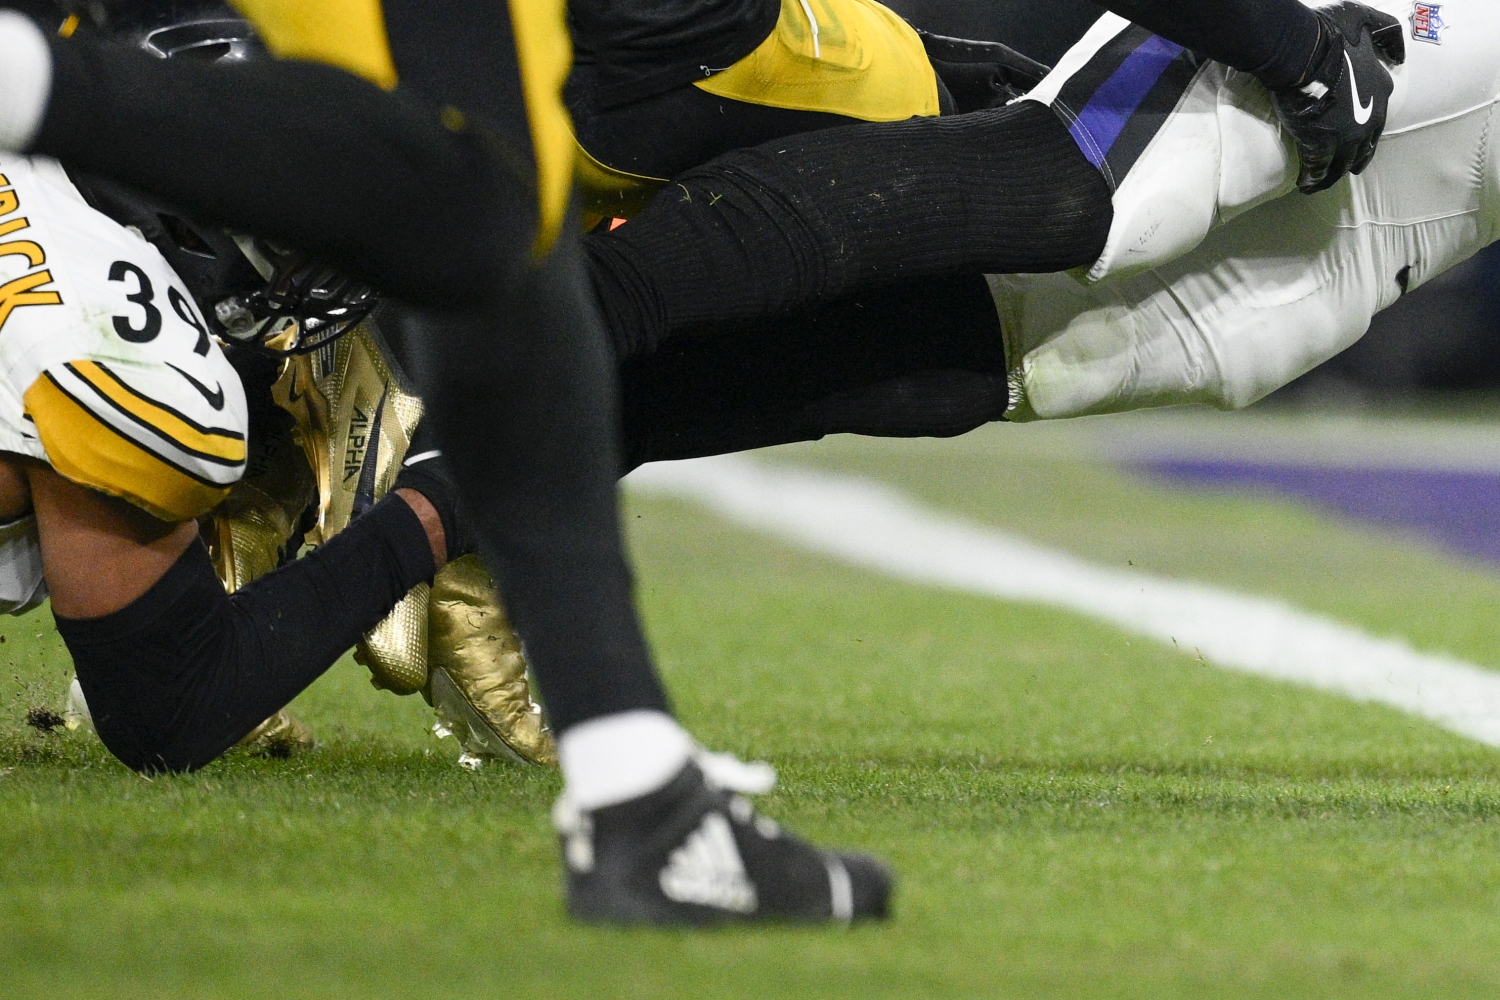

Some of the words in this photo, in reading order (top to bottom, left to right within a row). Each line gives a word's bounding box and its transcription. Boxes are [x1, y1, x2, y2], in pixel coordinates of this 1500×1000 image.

[1415, 5, 1429, 34] NFL
[107, 260, 211, 358] 39
[343, 405, 368, 483] ALPHA
